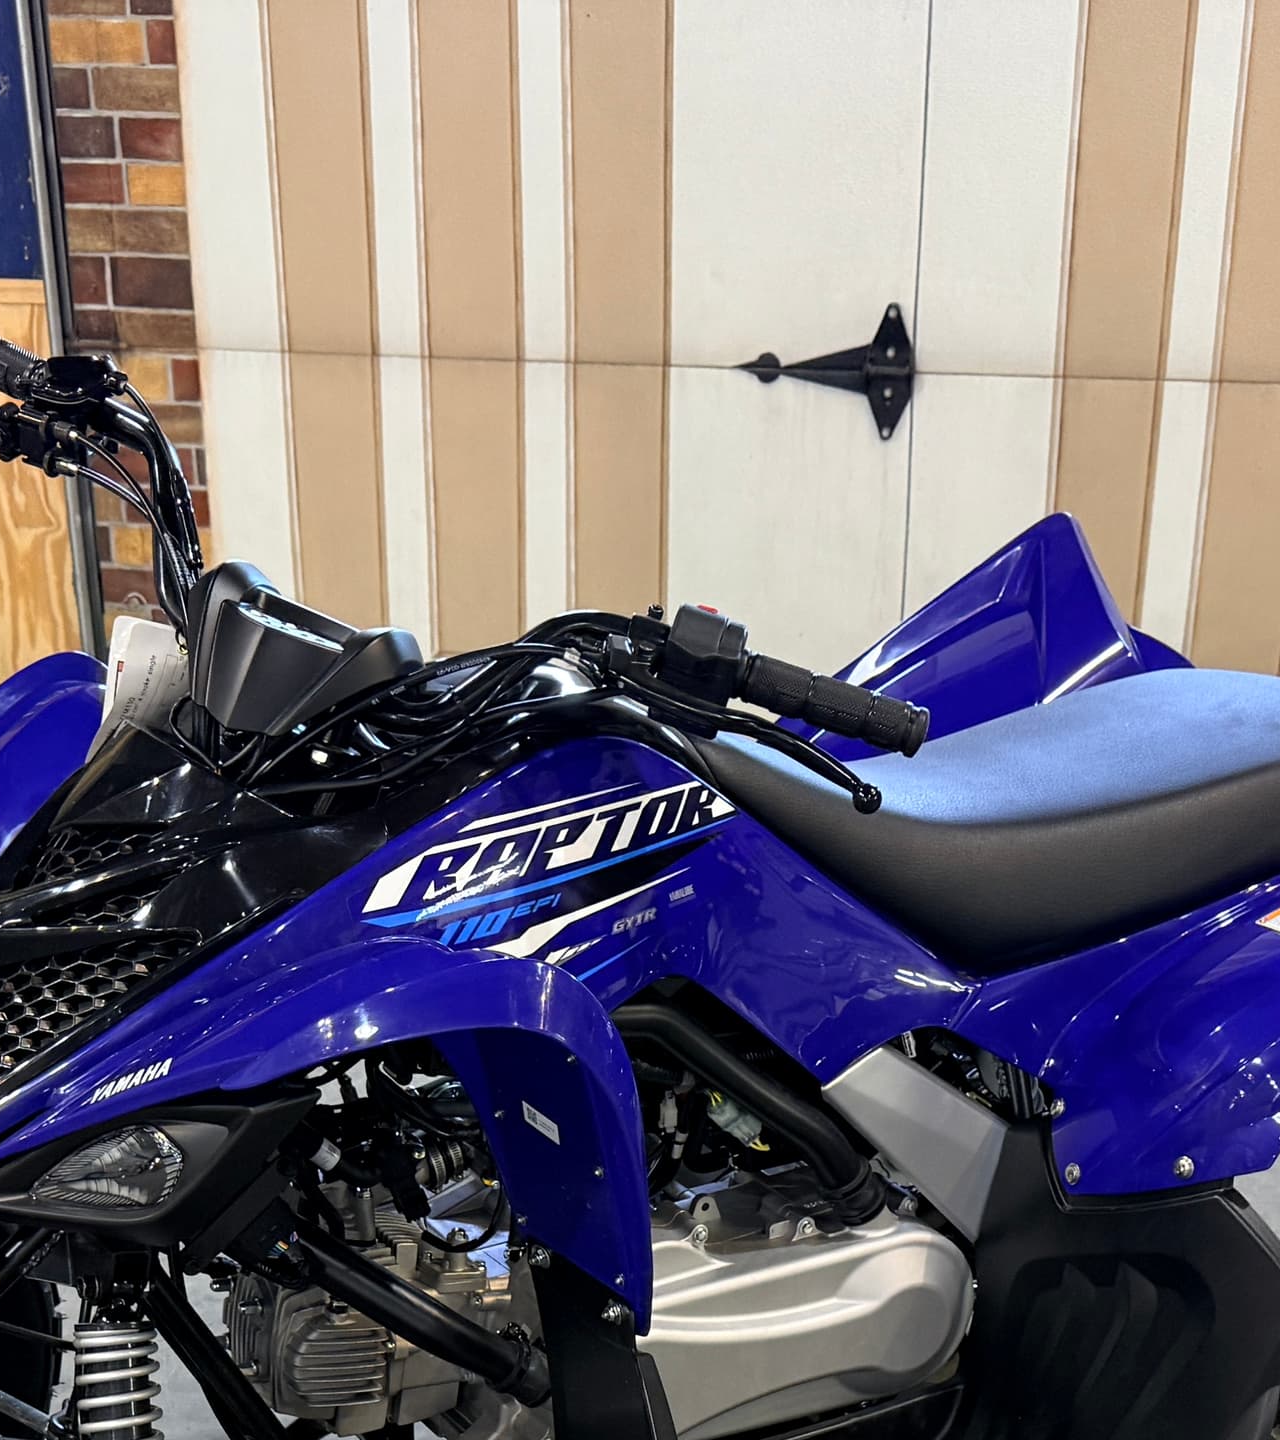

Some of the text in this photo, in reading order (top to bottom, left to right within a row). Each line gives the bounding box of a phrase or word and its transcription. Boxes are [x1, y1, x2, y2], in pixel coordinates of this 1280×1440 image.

[390, 782, 737, 908] RAPTOR
[440, 906, 515, 946] 110
[611, 906, 658, 935] GYTR
[89, 1057, 173, 1105] YAMAHA
